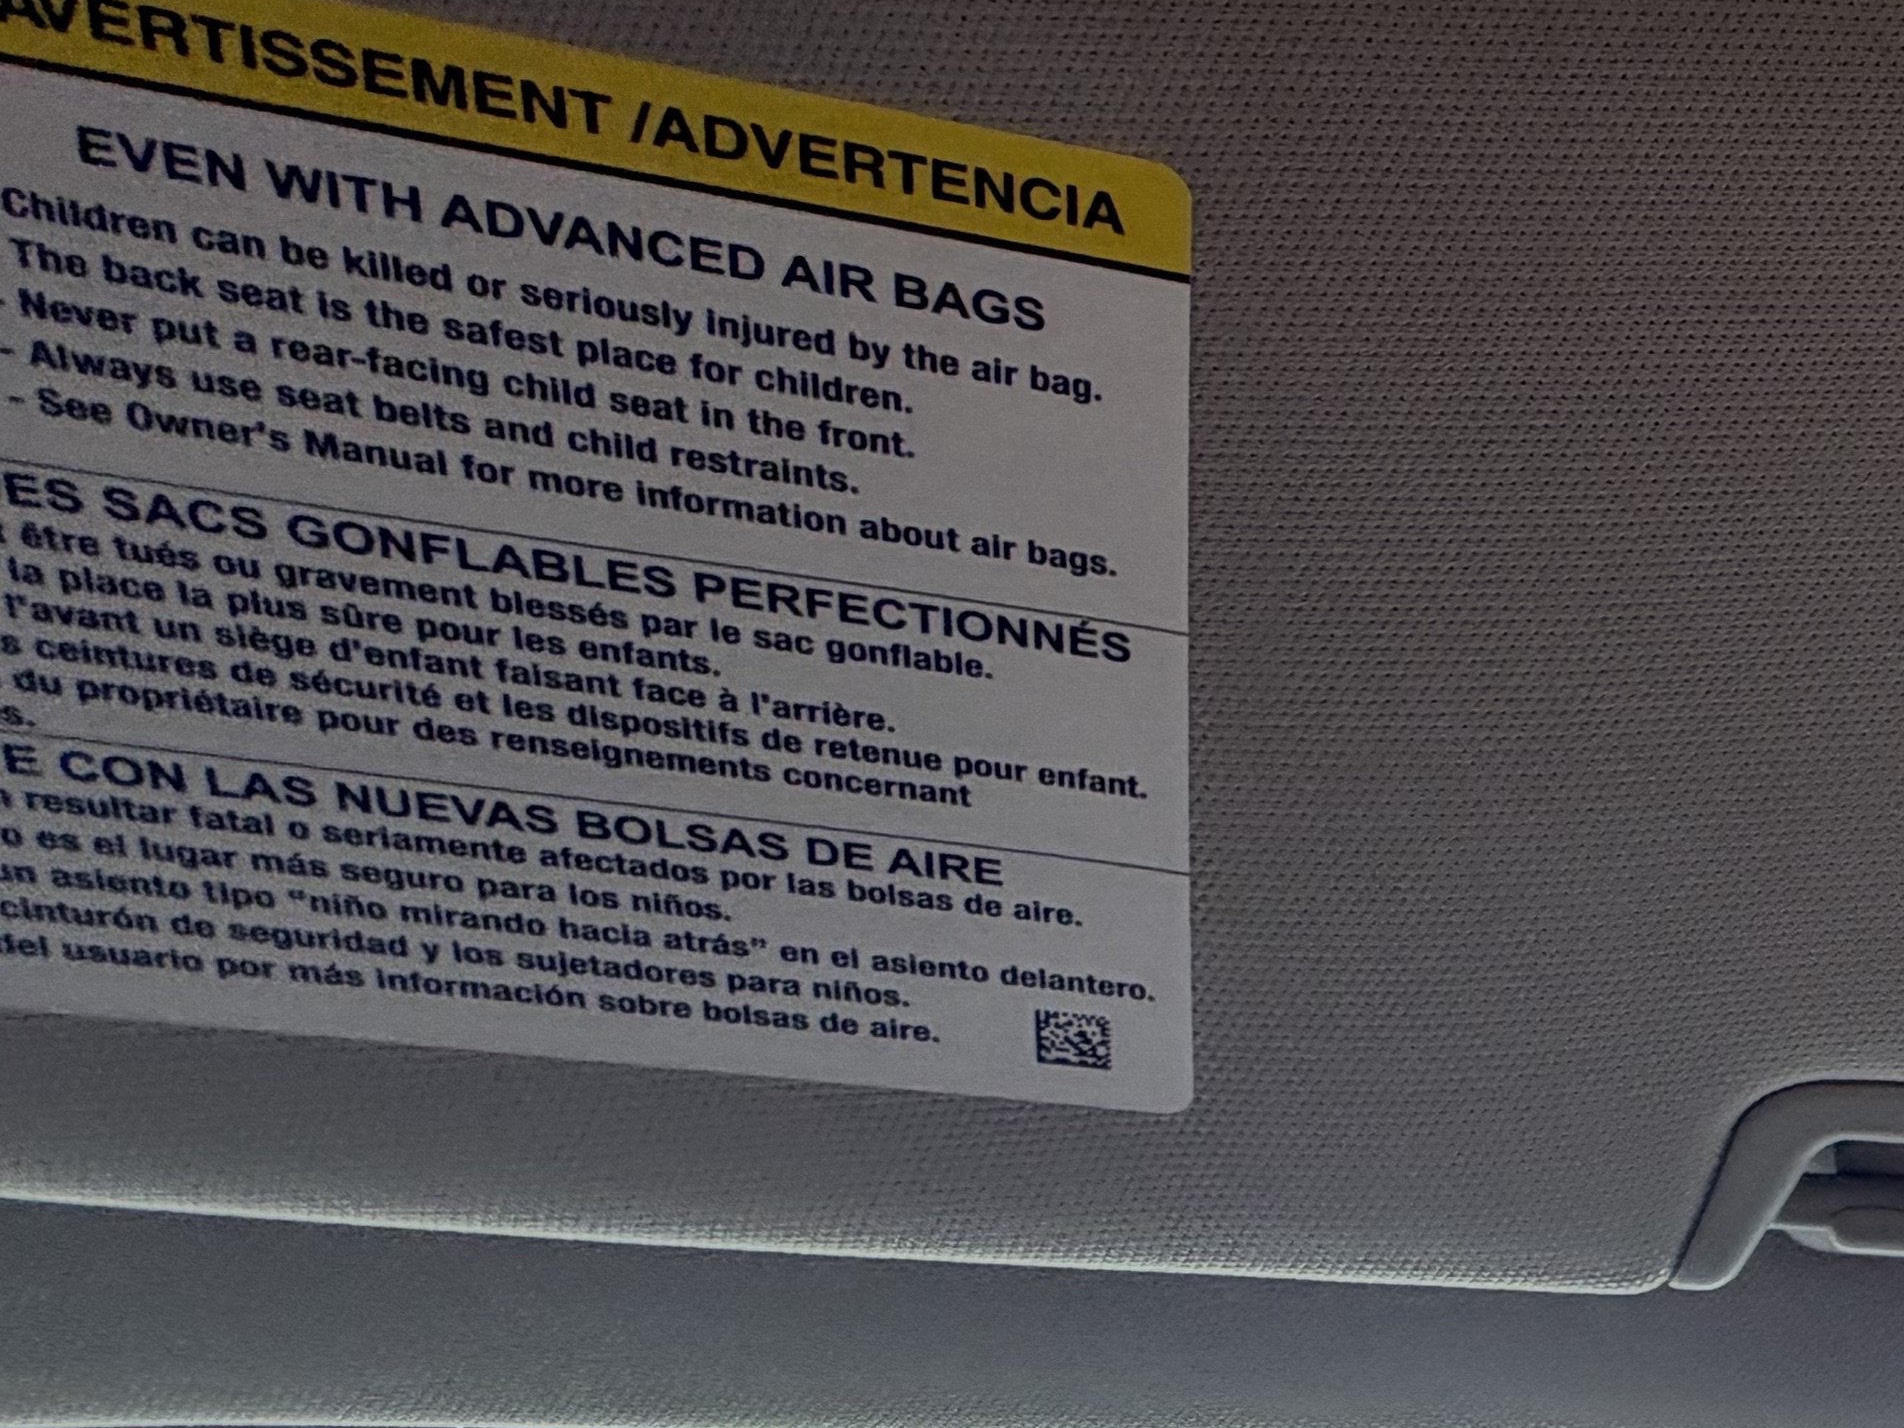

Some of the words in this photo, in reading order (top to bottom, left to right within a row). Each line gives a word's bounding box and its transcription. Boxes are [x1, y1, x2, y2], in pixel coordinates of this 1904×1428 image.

[77, 125, 246, 192] EVEN
[264, 159, 422, 223] WITH
[441, 194, 764, 280] ADVANCED
[782, 255, 876, 302] AIR
[895, 273, 1044, 331] BAGS
[629, 101, 1124, 236] /ADVERTENCIA
[1, 187, 177, 244] Children
[191, 226, 265, 260] can
[280, 236, 329, 270] be
[344, 246, 452, 293] killed
[468, 274, 506, 300] or
[520, 284, 692, 336] seriously
[707, 308, 834, 356] injured
[850, 331, 890, 369] by
[903, 344, 958, 376] the
[972, 357, 1018, 386] air
[1031, 365, 1101, 404] bag.
[9, 237, 89, 278] The
[102, 254, 204, 298] back
[217, 280, 305, 315] seat
[317, 290, 351, 322] is
[365, 300, 429, 335] the
[443, 318, 563, 357] safest
[577, 338, 676, 375] place
[690, 353, 742, 386] for
[756, 366, 912, 413] children.
[19, 288, 137, 335] Never
[151, 318, 220, 349] put
[234, 330, 256, 355] a
[272, 337, 488, 397] rear-facing
[504, 373, 595, 409] child
[610, 393, 688, 423] seat
[702, 400, 734, 431] in
[748, 409, 805, 441] the
[818, 420, 914, 458] front.
[30, 340, 177, 389] Always
[191, 371, 262, 403] use
[276, 385, 362, 418] seat
[374, 394, 470, 434] belts
[485, 418, 553, 448] and
[568, 429, 657, 463] child
[671, 446, 858, 494] restraints.
[36, 388, 112, 425] See
[127, 401, 290, 452] Owner's
[304, 429, 447, 476] Manual
[461, 454, 514, 486] for
[529, 470, 623, 502] more
[637, 480, 845, 535] information
[860, 517, 960, 552] about
[972, 535, 1016, 560] air
[1029, 540, 1116, 577] bags.
[8, 556, 44, 586] la
[59, 567, 165, 602] place
[176, 580, 213, 610] la
[227, 589, 307, 620] plus
[321, 603, 402, 635] sûre
[416, 618, 500, 646] pour
[512, 626, 566, 655] les
[579, 640, 720, 676] enfants.
[21, 521, 101, 558] être
[112, 534, 201, 571] tués
[213, 555, 261, 579] ou
[275, 563, 478, 610] gravement
[491, 588, 628, 629] blessés
[642, 614, 697, 639] par
[711, 618, 740, 644] le
[754, 630, 813, 655] sac
[827, 640, 992, 679] gonflable.
[103, 486, 267, 540] SACS
[288, 514, 676, 598] GONFLABLES
[694, 572, 1130, 662] PERFECTIONNÉS
[3, 593, 142, 636] l'avant
[152, 618, 202, 643] un
[215, 623, 317, 660] siège
[330, 638, 484, 680] d'enfant
[494, 658, 621, 697] faisant
[632, 677, 705, 708] face
[719, 687, 739, 713] à
[752, 692, 894, 732] l'arrière.
[34, 638, 217, 680] ceintures
[231, 660, 277, 688] de
[290, 669, 441, 709] sécurité
[455, 690, 490, 715] et
[504, 694, 555, 722] les
[567, 704, 749, 746] dispositifs
[762, 728, 801, 754] de
[815, 739, 941, 771] retenue
[955, 757, 1027, 782] pour
[1039, 768, 1146, 799] enfant.
[12, 668, 62, 696] du
[76, 679, 302, 726] propriétaire
[317, 710, 399, 736] pour
[414, 717, 478, 746] des
[491, 731, 770, 782] renseignements
[784, 768, 971, 807] concernant
[25, 792, 177, 827] resultar
[189, 805, 274, 836] fatal
[288, 821, 309, 840] o
[322, 825, 526, 864] seriamente
[540, 847, 709, 884] afectados
[720, 870, 776, 891] por
[788, 873, 835, 898] las
[848, 879, 952, 911] bolsas
[965, 894, 1001, 917] de
[1014, 901, 1081, 926] aire.
[36, 831, 81, 852] es
[93, 834, 127, 857] el
[140, 836, 238, 870] lugar
[252, 852, 329, 878] más
[341, 863, 463, 892] seguro
[478, 878, 556, 903] para
[569, 883, 620, 909] los
[632, 893, 730, 921] niños.
[60, 751, 187, 794] CON
[206, 767, 317, 807] LAS
[336, 782, 558, 834] NUEVAS
[577, 810, 788, 861] BOLSAS
[807, 837, 873, 871] DE
[888, 849, 1002, 887] AIRE
[1, 897, 158, 933] cinturón
[171, 914, 215, 939] de
[229, 924, 408, 957] seguridad
[421, 943, 439, 965] y
[453, 940, 504, 966] los
[517, 951, 715, 988] sujetadores
[728, 974, 799, 996] para
[814, 980, 909, 1007] niños.
[52, 868, 191, 900] asiento
[203, 881, 275, 910] tipo
[400, 903, 547, 936] mirando
[559, 917, 651, 947] hacia
[781, 945, 818, 964] en
[832, 948, 858, 969] el
[872, 954, 988, 982] asiento
[1001, 966, 1154, 1001] delantero.
[63, 942, 203, 972] usuario
[215, 958, 275, 979] por
[289, 962, 364, 987] más
[377, 968, 585, 1008] información
[599, 994, 691, 1018] sobre
[704, 1000, 809, 1030] bolsas
[820, 1013, 858, 1035] de
[871, 1018, 939, 1042] aire.
